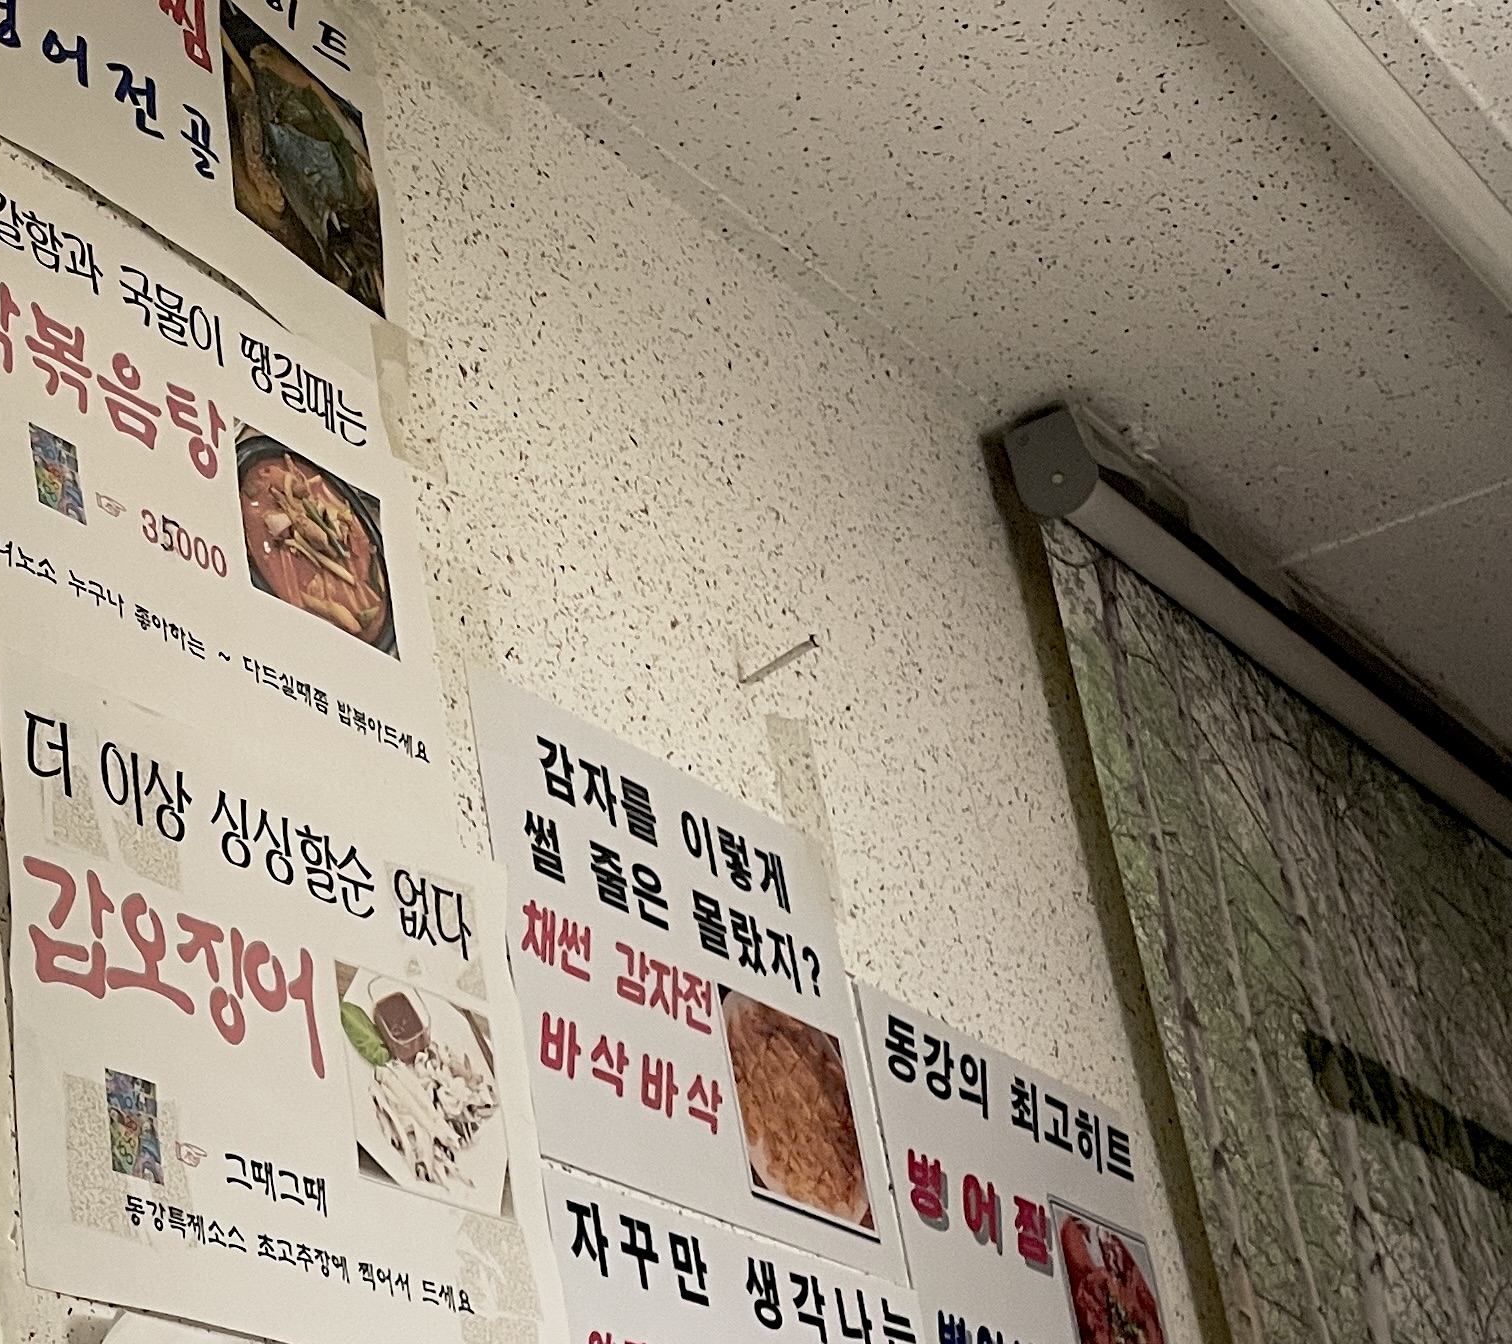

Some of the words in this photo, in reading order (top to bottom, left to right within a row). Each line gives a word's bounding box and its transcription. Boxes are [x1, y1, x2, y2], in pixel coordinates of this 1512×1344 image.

[118, 264, 224, 366] 국물이
[240, 333, 367, 446] 땡길때는
[141, 509, 226, 577] 35000
[68, 569, 125, 619] 누구나
[134, 604, 205, 660] 좋아하는
[242, 655, 329, 715] 다드실때쯤
[337, 699, 430, 763] 밥볶아드세요
[24, 710, 74, 797] 더
[101, 741, 192, 842] 이상
[210, 790, 375, 919] 싱싱할순
[394, 868, 471, 960] 없다
[524, 810, 565, 884] 썰
[590, 839, 669, 931] 줄은
[692, 889, 822, 997] 몰랐지?
[536, 735, 658, 847] 감자를
[681, 811, 790, 913] 이렇게
[23, 855, 326, 1079] 갑오징어
[521, 899, 591, 981] 채썬
[615, 940, 713, 1035] 감자전
[225, 1152, 328, 1217] 그때그때
[884, 1014, 990, 1119] 동강의
[1010, 1076, 1134, 1182] 최고히트
[125, 1194, 247, 1253] 동강특제소스
[257, 1233, 350, 1284] 초고추장에
[358, 1259, 412, 1301] 찍어서
[422, 1280, 475, 1314] 드세요
[566, 1199, 710, 1307] 자꾸만
